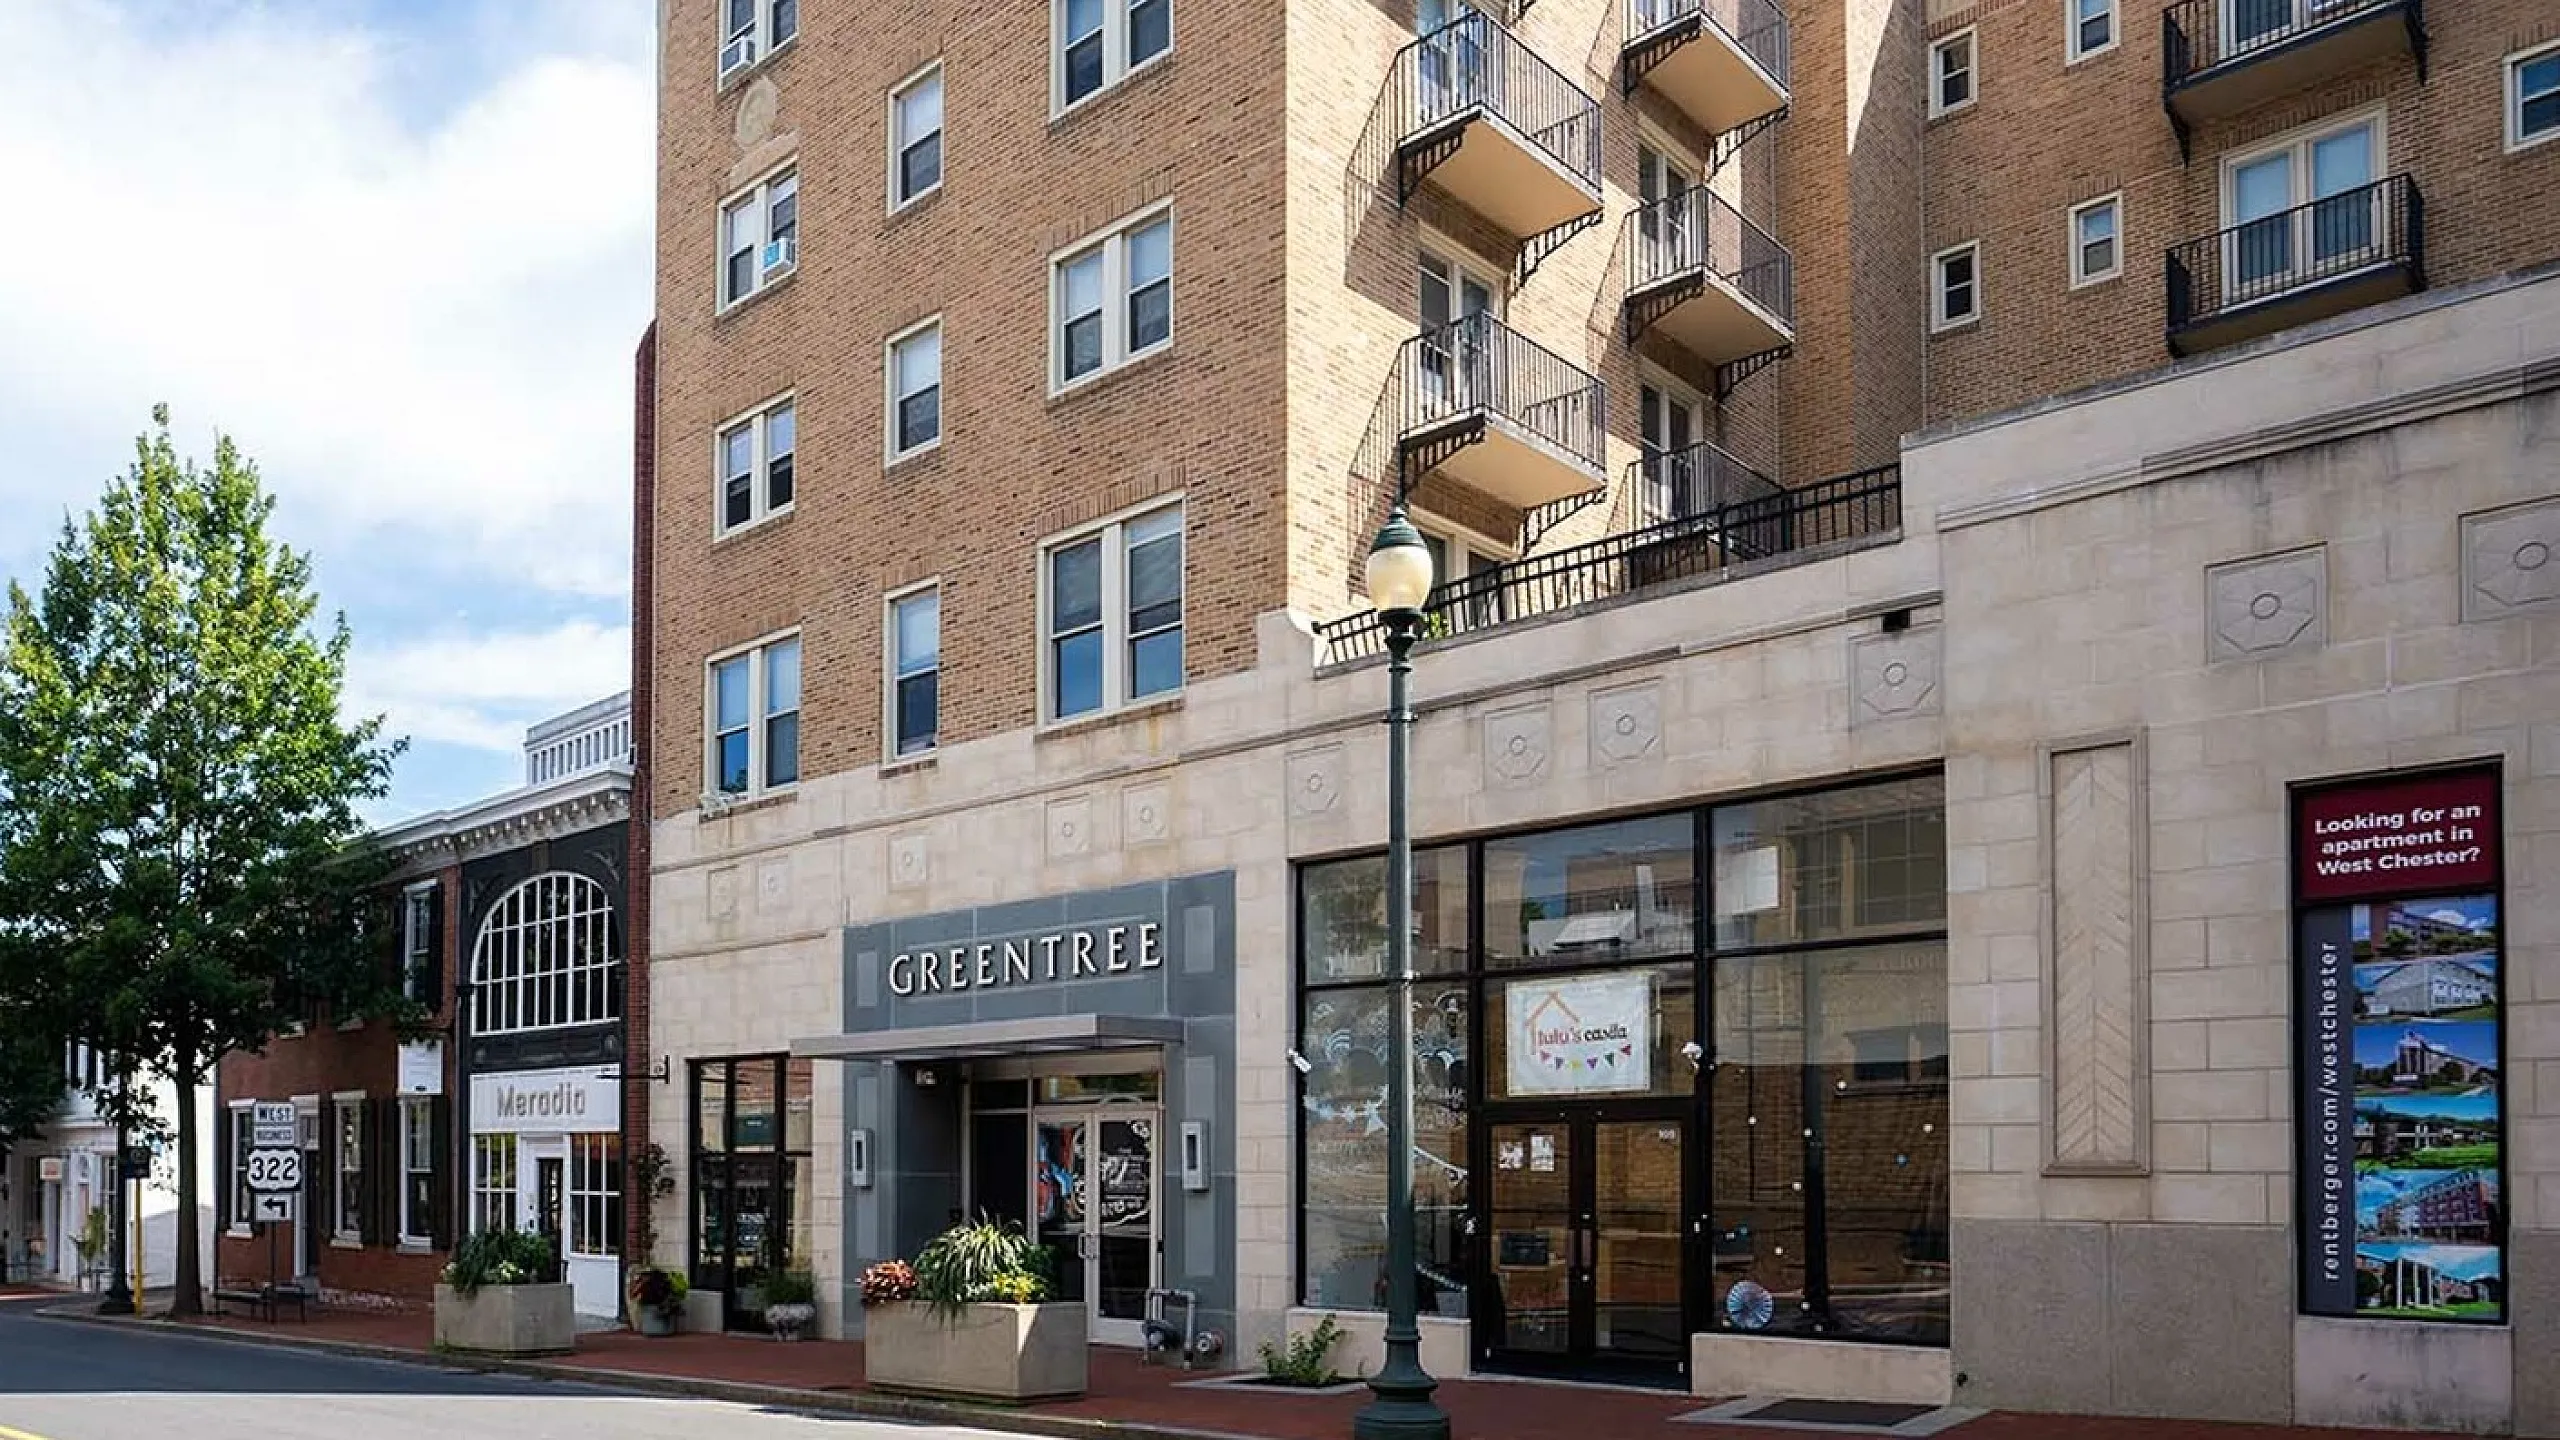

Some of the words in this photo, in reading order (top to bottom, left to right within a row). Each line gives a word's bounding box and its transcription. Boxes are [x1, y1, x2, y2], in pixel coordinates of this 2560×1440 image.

[2315, 812, 2404, 834] Looking
[2411, 807, 2445, 823] for
[2451, 805, 2481, 820] an
[2321, 829, 2445, 856] apartment
[2450, 825, 2473, 842] in
[2317, 857, 2373, 876] West
[2378, 846, 2481, 869] Chester?
[889, 923, 1162, 995] GREENTREE
[257, 1107, 293, 1121] WEST
[497, 1081, 586, 1118] Meradia
[2318, 943, 2342, 1282] rentberger.com/westchester
[251, 1156, 296, 1181] 322
